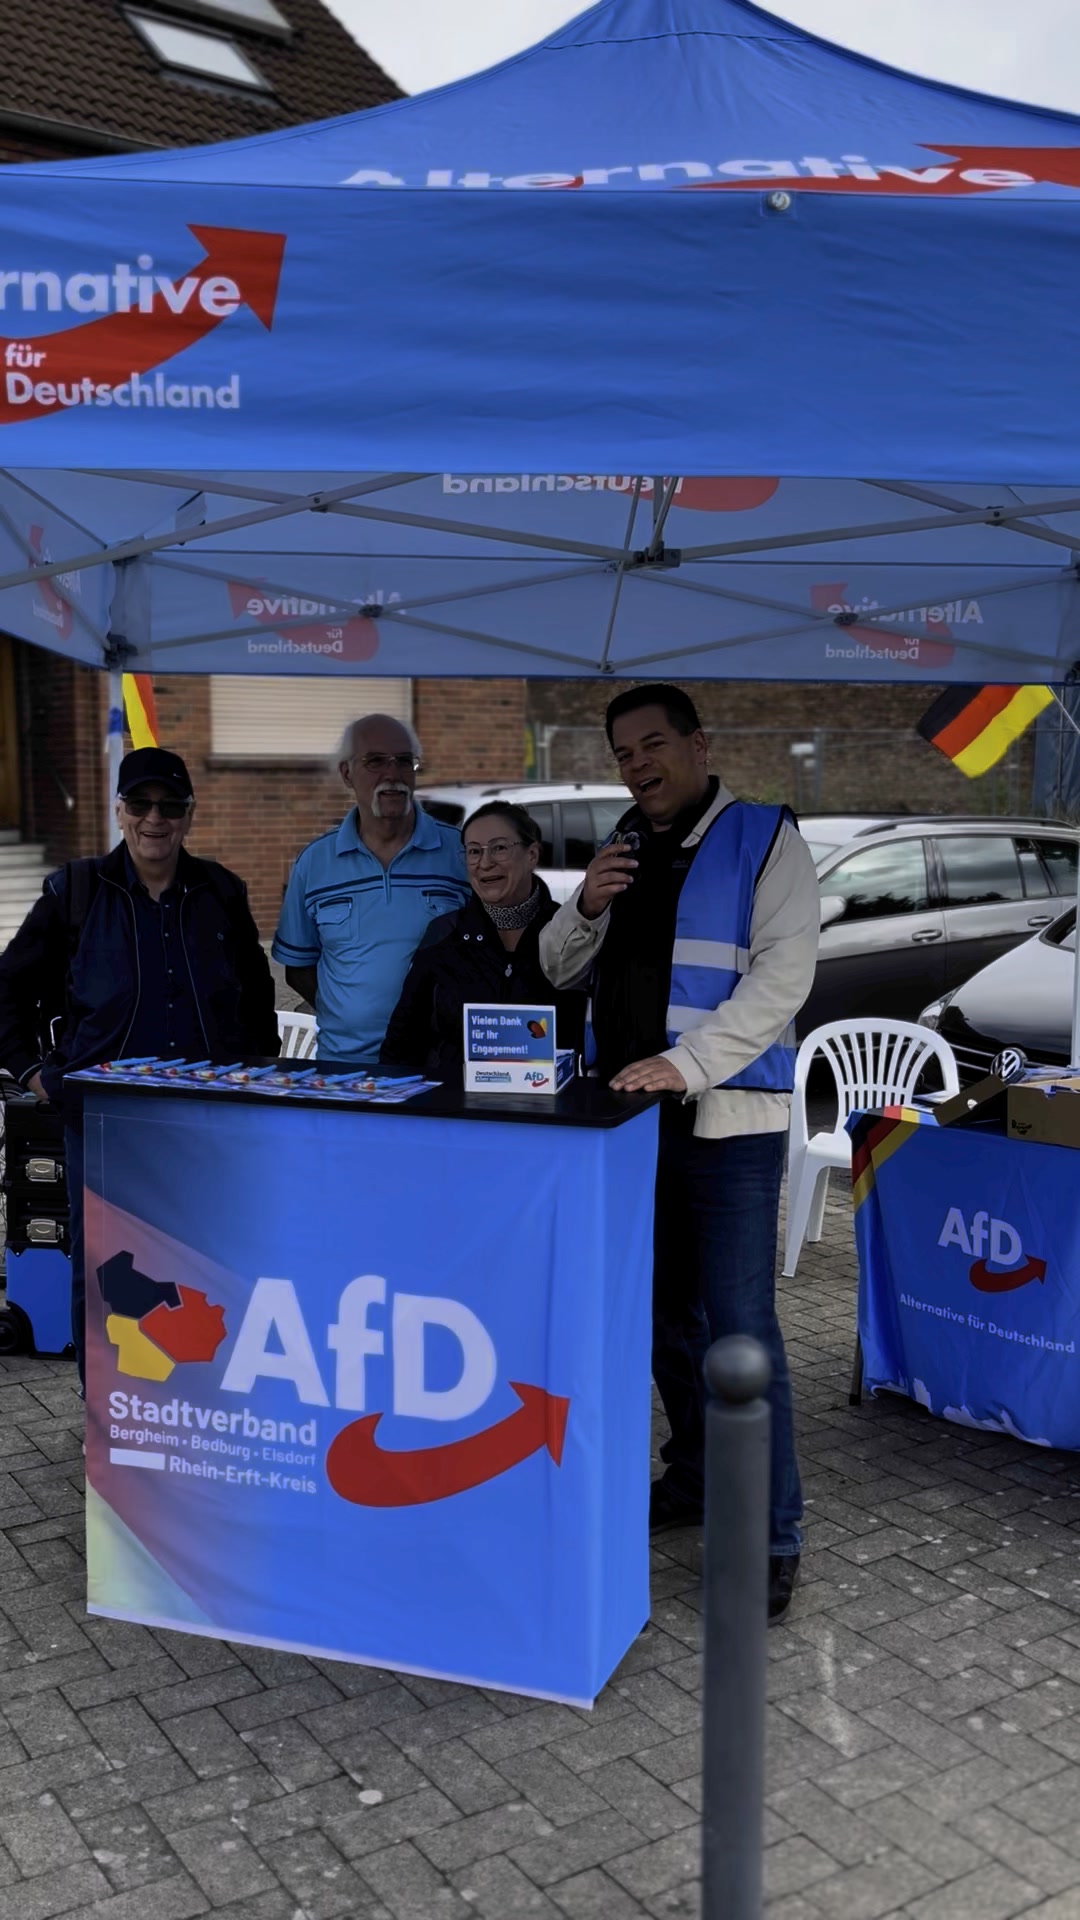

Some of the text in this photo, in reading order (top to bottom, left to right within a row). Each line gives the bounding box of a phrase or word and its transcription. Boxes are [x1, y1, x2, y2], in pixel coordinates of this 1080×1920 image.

[5, 343, 46, 369] für
[5, 373, 240, 410] Deutschland
[471, 1016, 522, 1026] Vielen Dank
[472, 1029, 499, 1039] für Ihr
[472, 1043, 528, 1056] Engagement!
[524, 1072, 544, 1081] AfD
[937, 1207, 1022, 1266] AfD
[900, 1293, 1075, 1354] Alternative für Deutschland
[220, 1275, 496, 1421] AfD
[109, 1391, 317, 1446] Stadtverband
[110, 1424, 316, 1467] Bergheim Bedburg Elsdorf
[169, 1455, 317, 1494] Rhein-Erft-Kreis
